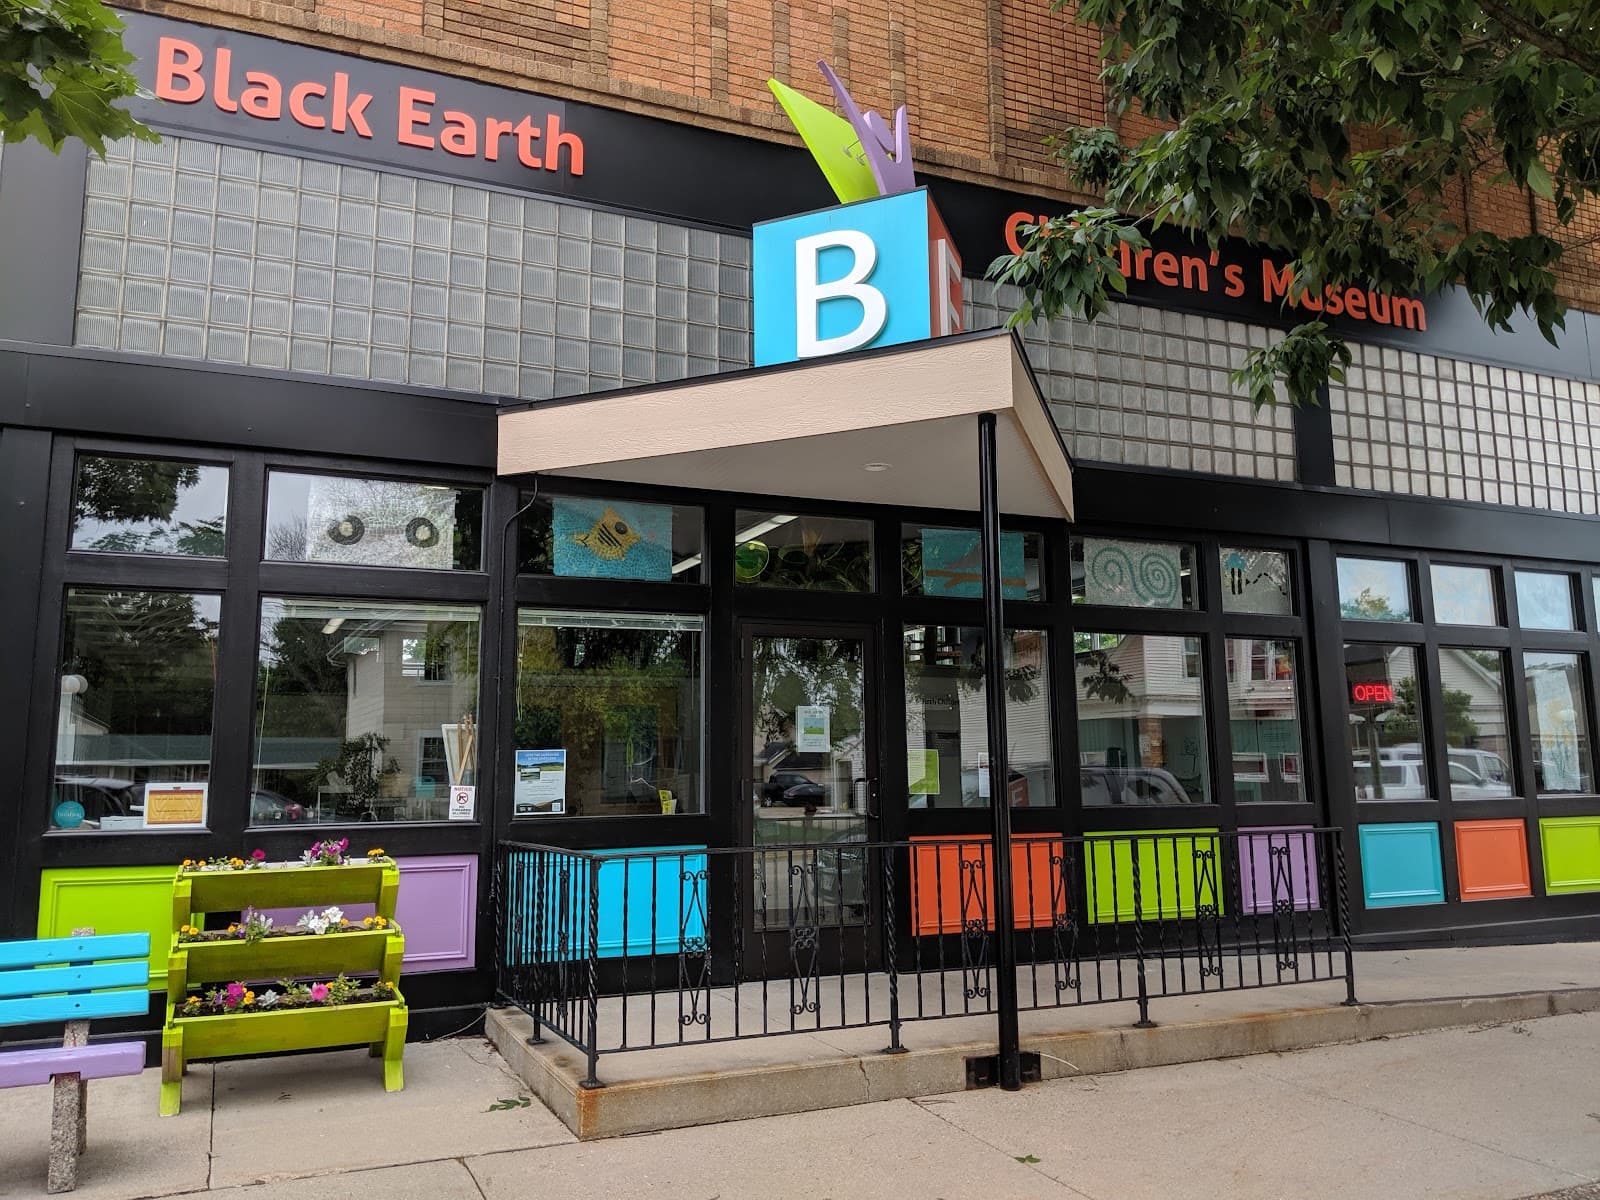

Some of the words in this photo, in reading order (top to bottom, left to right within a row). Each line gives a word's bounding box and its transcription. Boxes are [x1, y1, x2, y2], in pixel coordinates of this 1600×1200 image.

[155, 36, 373, 138] Black
[397, 86, 585, 176] Earth
[795, 229, 888, 358] B
[1353, 684, 1394, 702] OPEN
